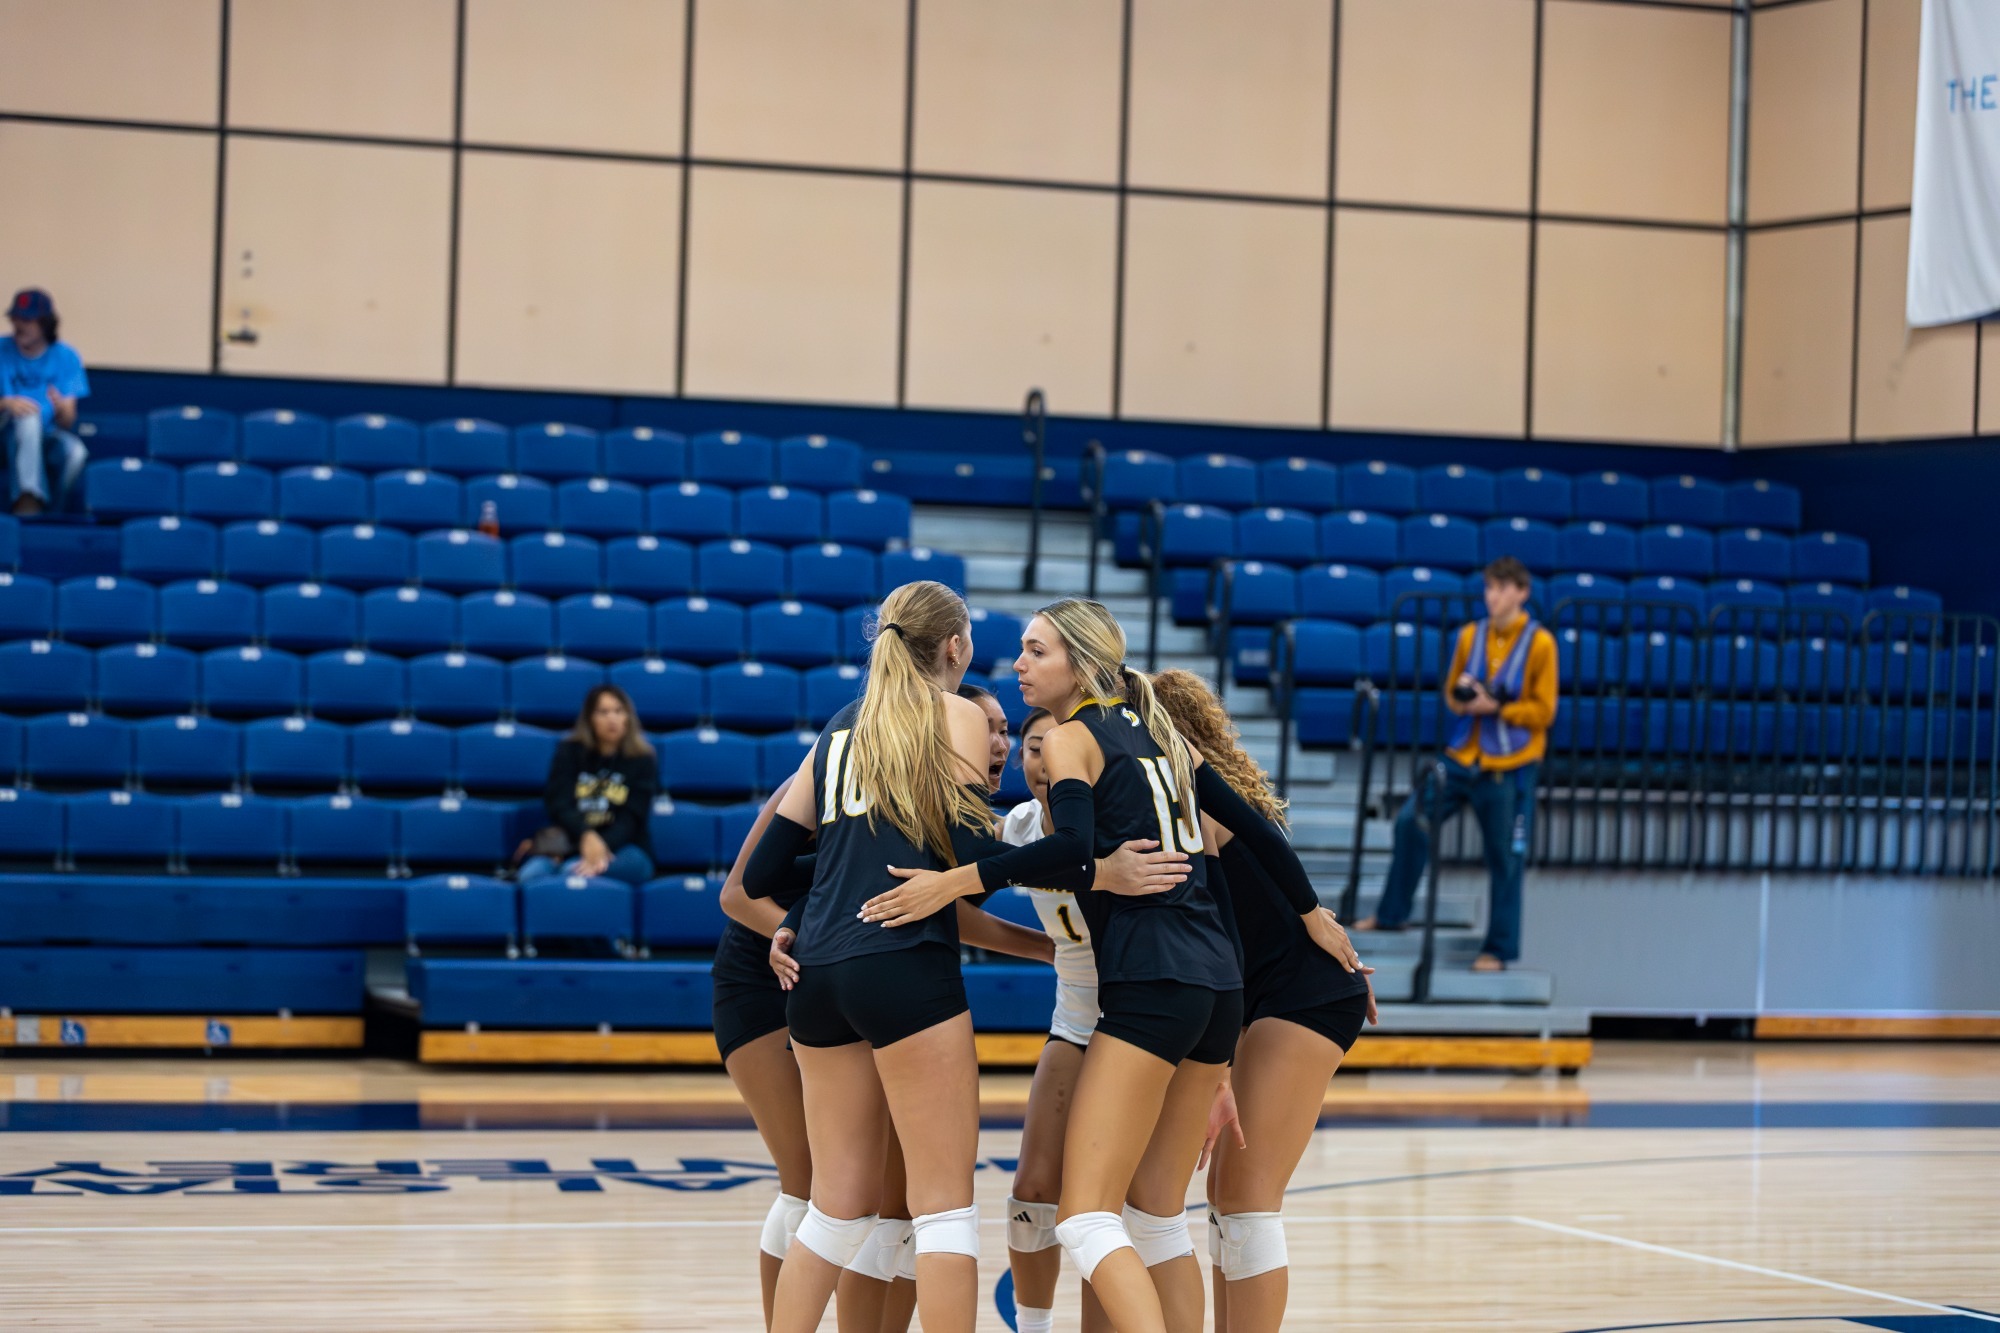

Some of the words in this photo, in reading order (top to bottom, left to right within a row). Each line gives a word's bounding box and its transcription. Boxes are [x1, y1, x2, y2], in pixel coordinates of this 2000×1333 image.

[1946, 75, 1998, 113] THE
[1057, 904, 1082, 944] 1
[475, 1173, 781, 1192] AL
